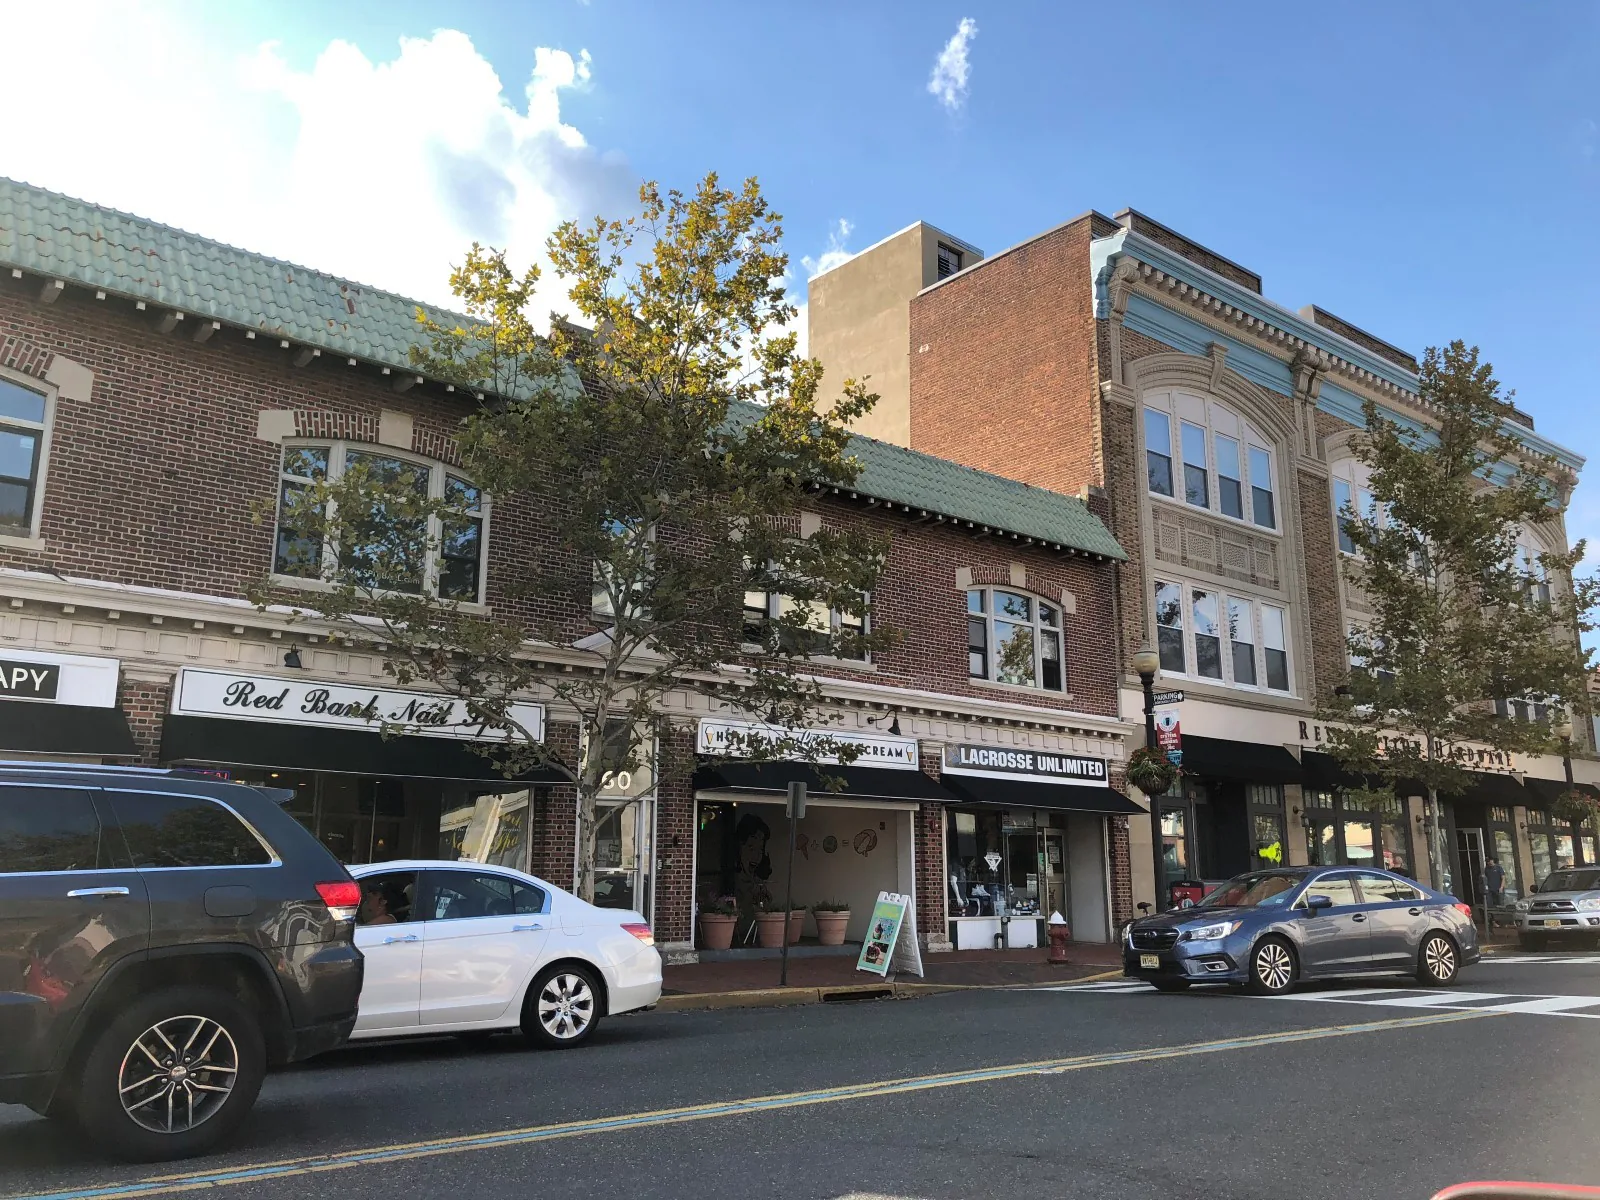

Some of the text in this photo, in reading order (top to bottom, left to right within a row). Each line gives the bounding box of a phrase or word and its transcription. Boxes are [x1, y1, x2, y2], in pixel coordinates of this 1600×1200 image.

[222, 681, 290, 710] Red
[1153, 691, 1178, 701] PARKING
[865, 746, 903, 758] CREAM
[960, 747, 1104, 777] LACROSSE UNLIMITED
